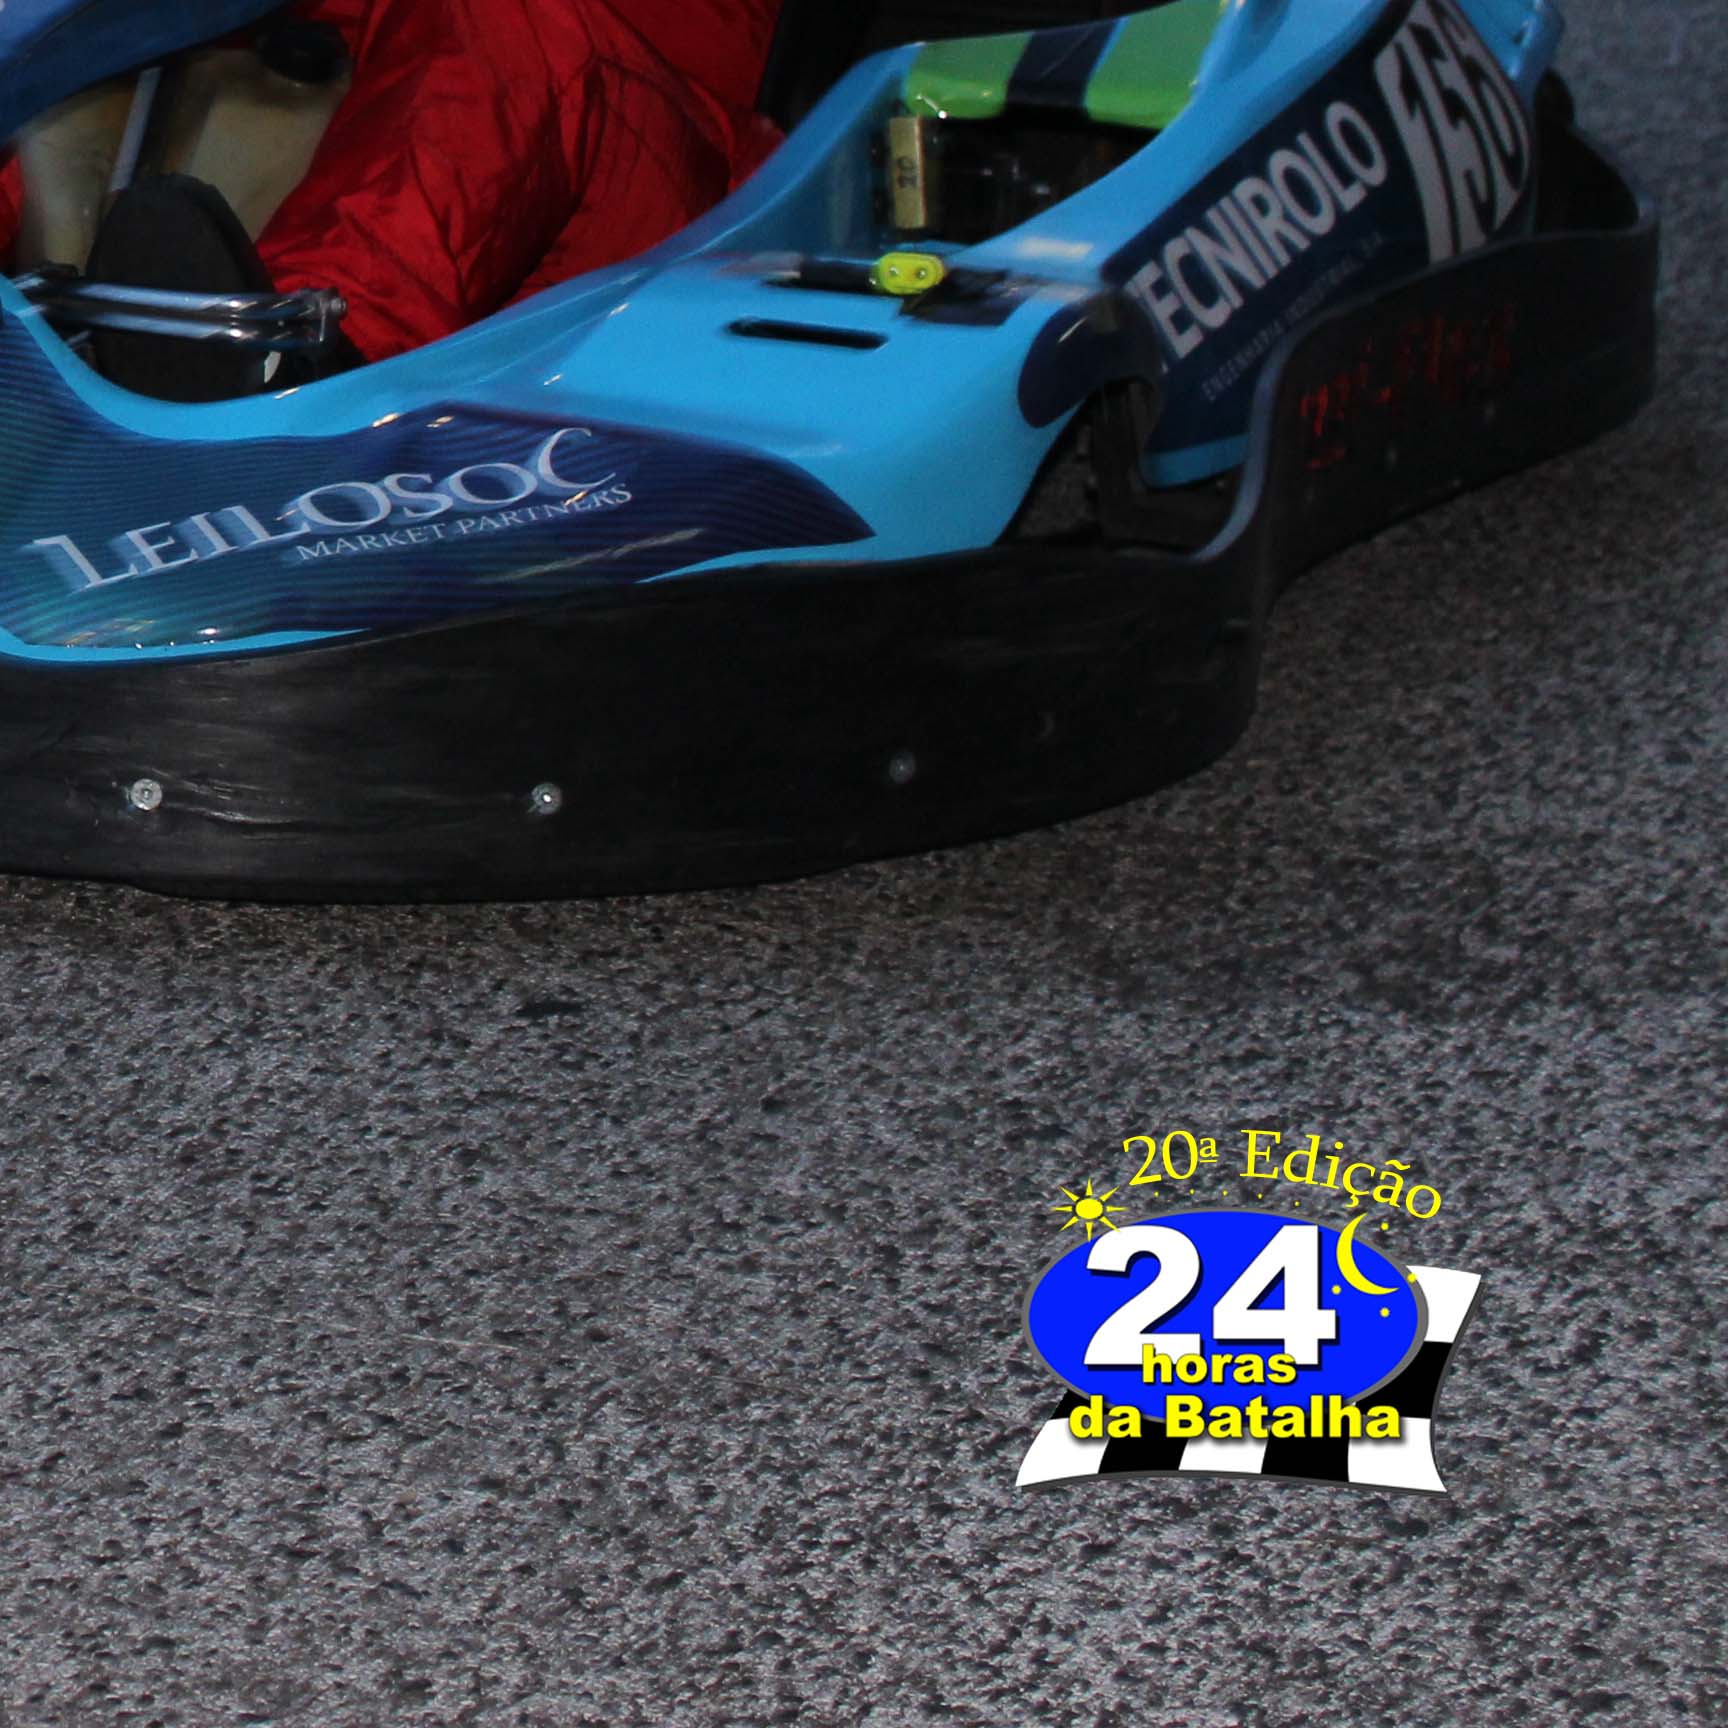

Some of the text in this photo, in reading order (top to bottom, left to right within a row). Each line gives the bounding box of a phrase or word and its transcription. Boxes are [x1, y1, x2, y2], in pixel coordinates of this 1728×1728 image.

[33, 427, 617, 589] LEILOSOC
[297, 483, 633, 562] MARKET PARTNERS
